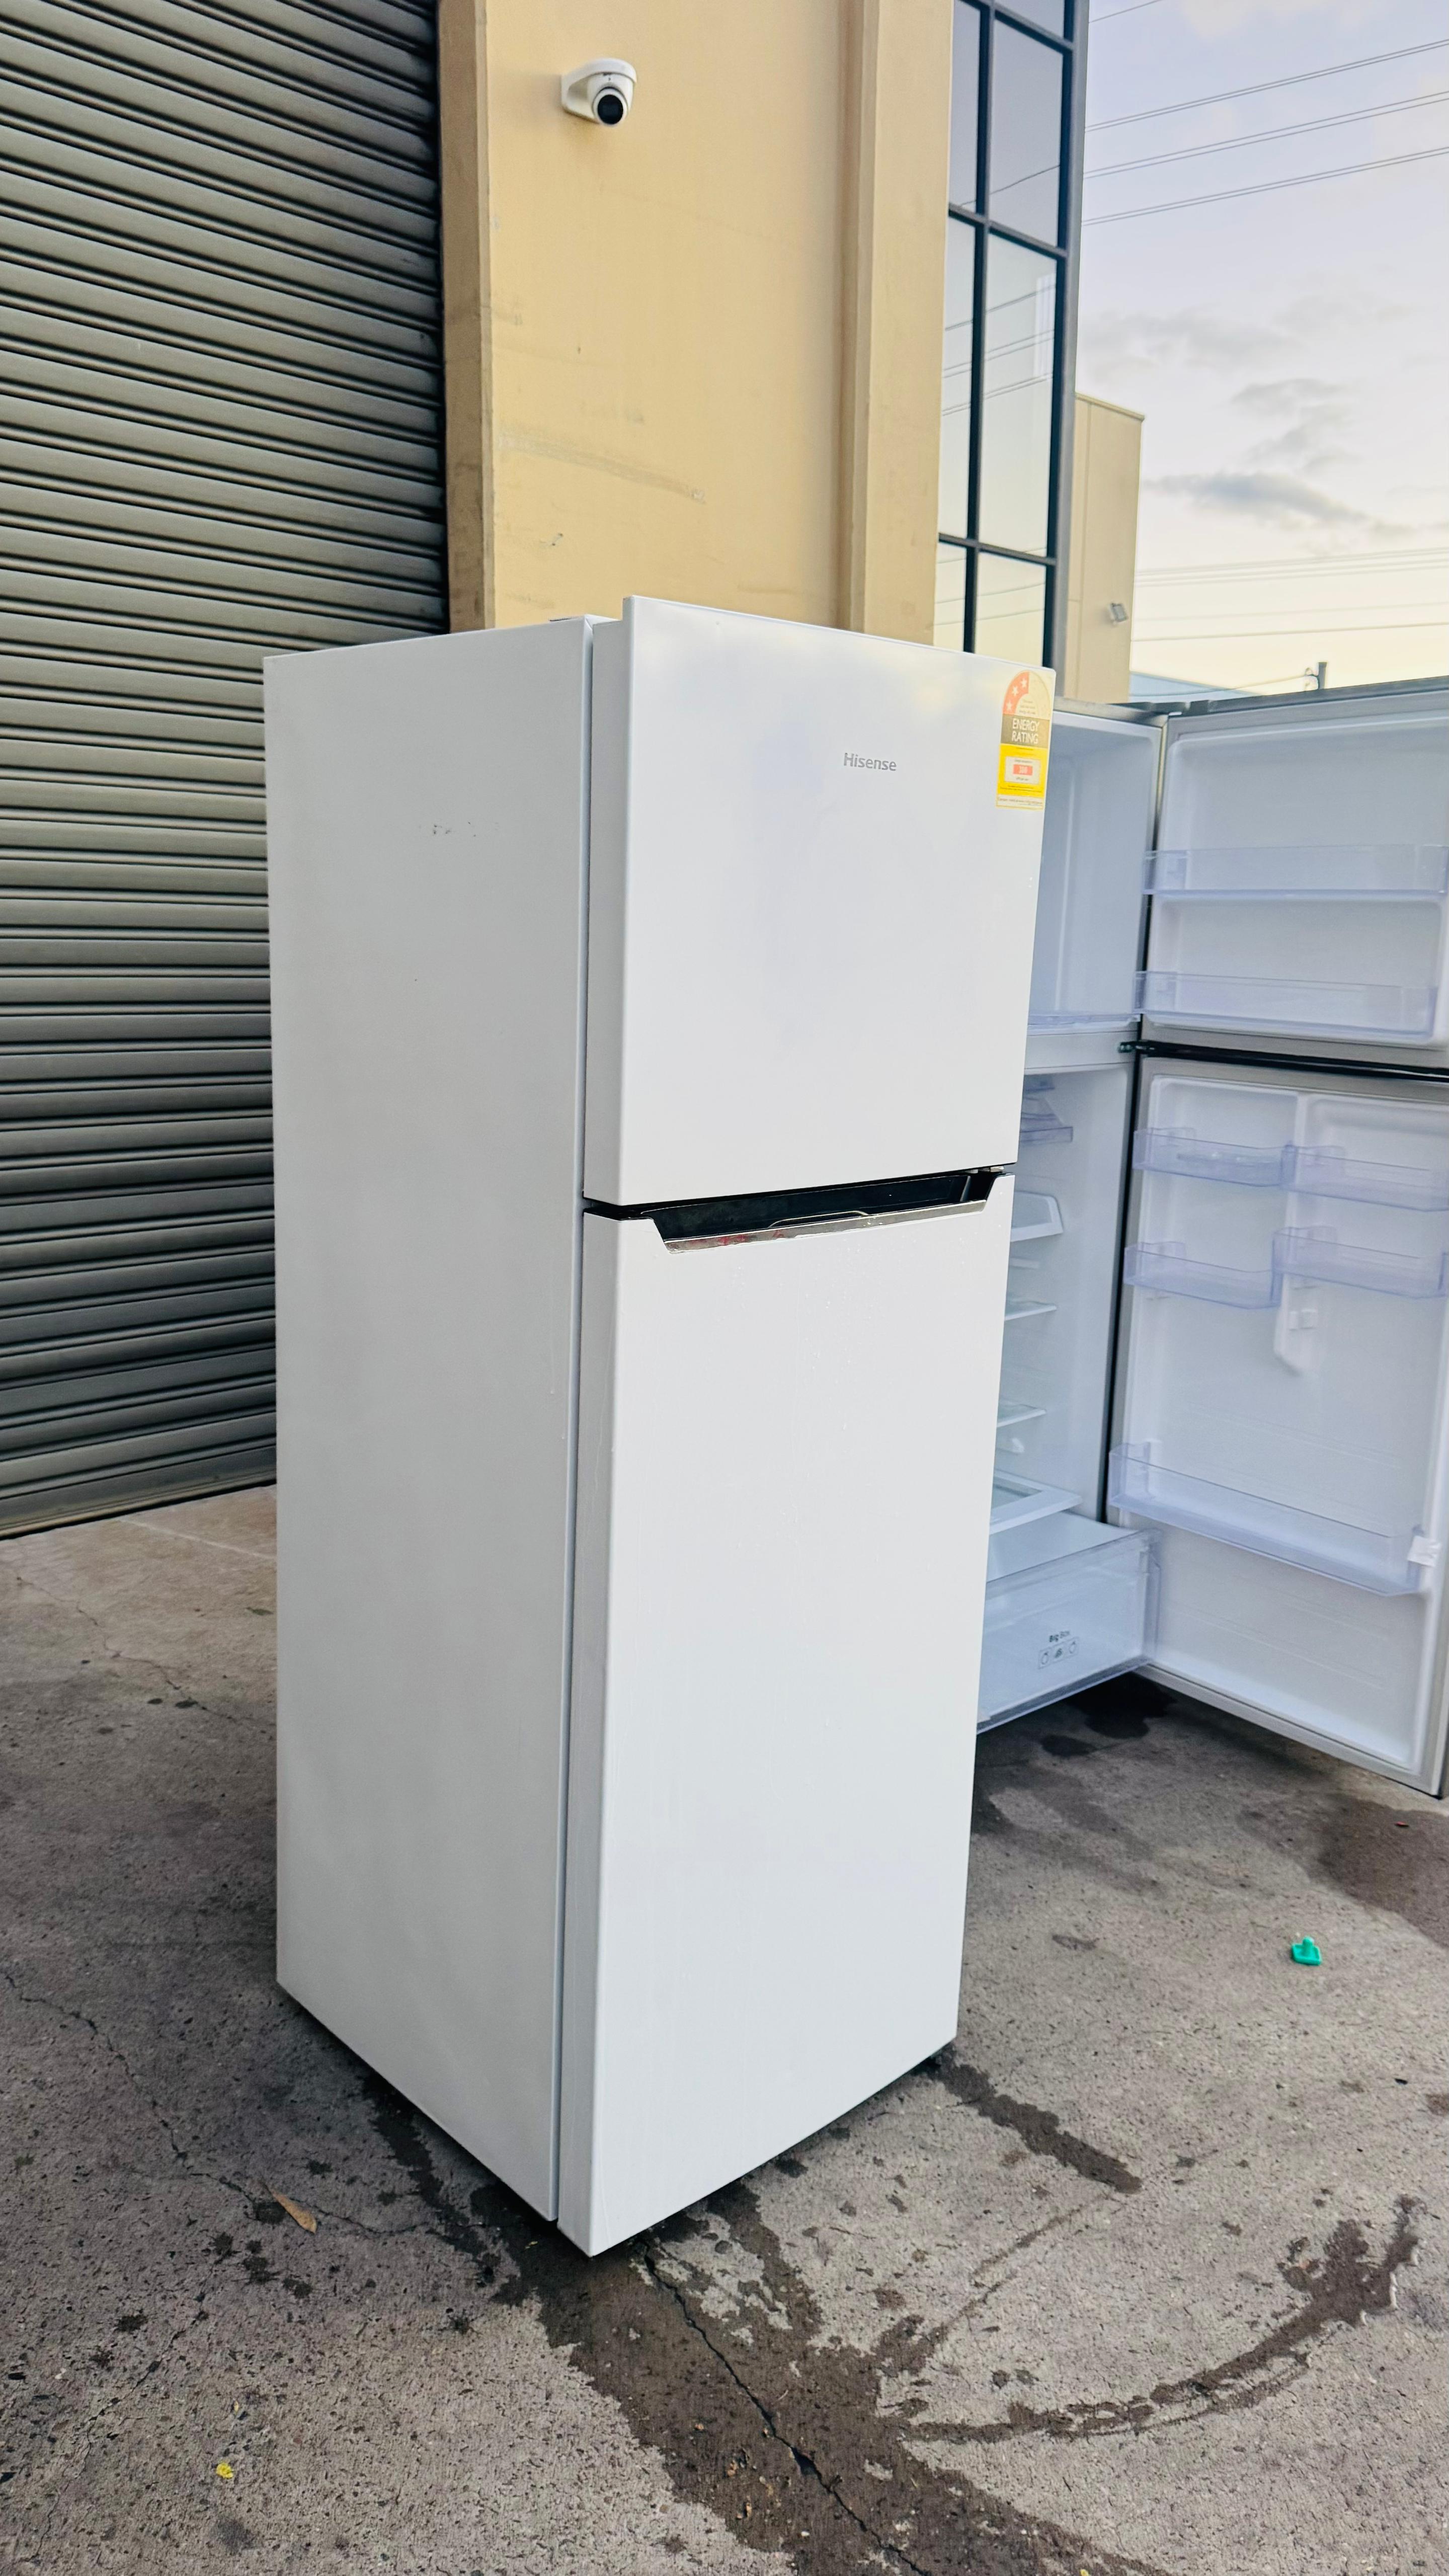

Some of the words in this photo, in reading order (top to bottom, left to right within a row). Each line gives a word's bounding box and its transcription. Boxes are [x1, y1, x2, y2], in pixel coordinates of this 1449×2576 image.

[1012, 718, 1039, 732] ENERGY
[1011, 731, 1039, 744] RATING
[844, 753, 897, 771] Hisense
